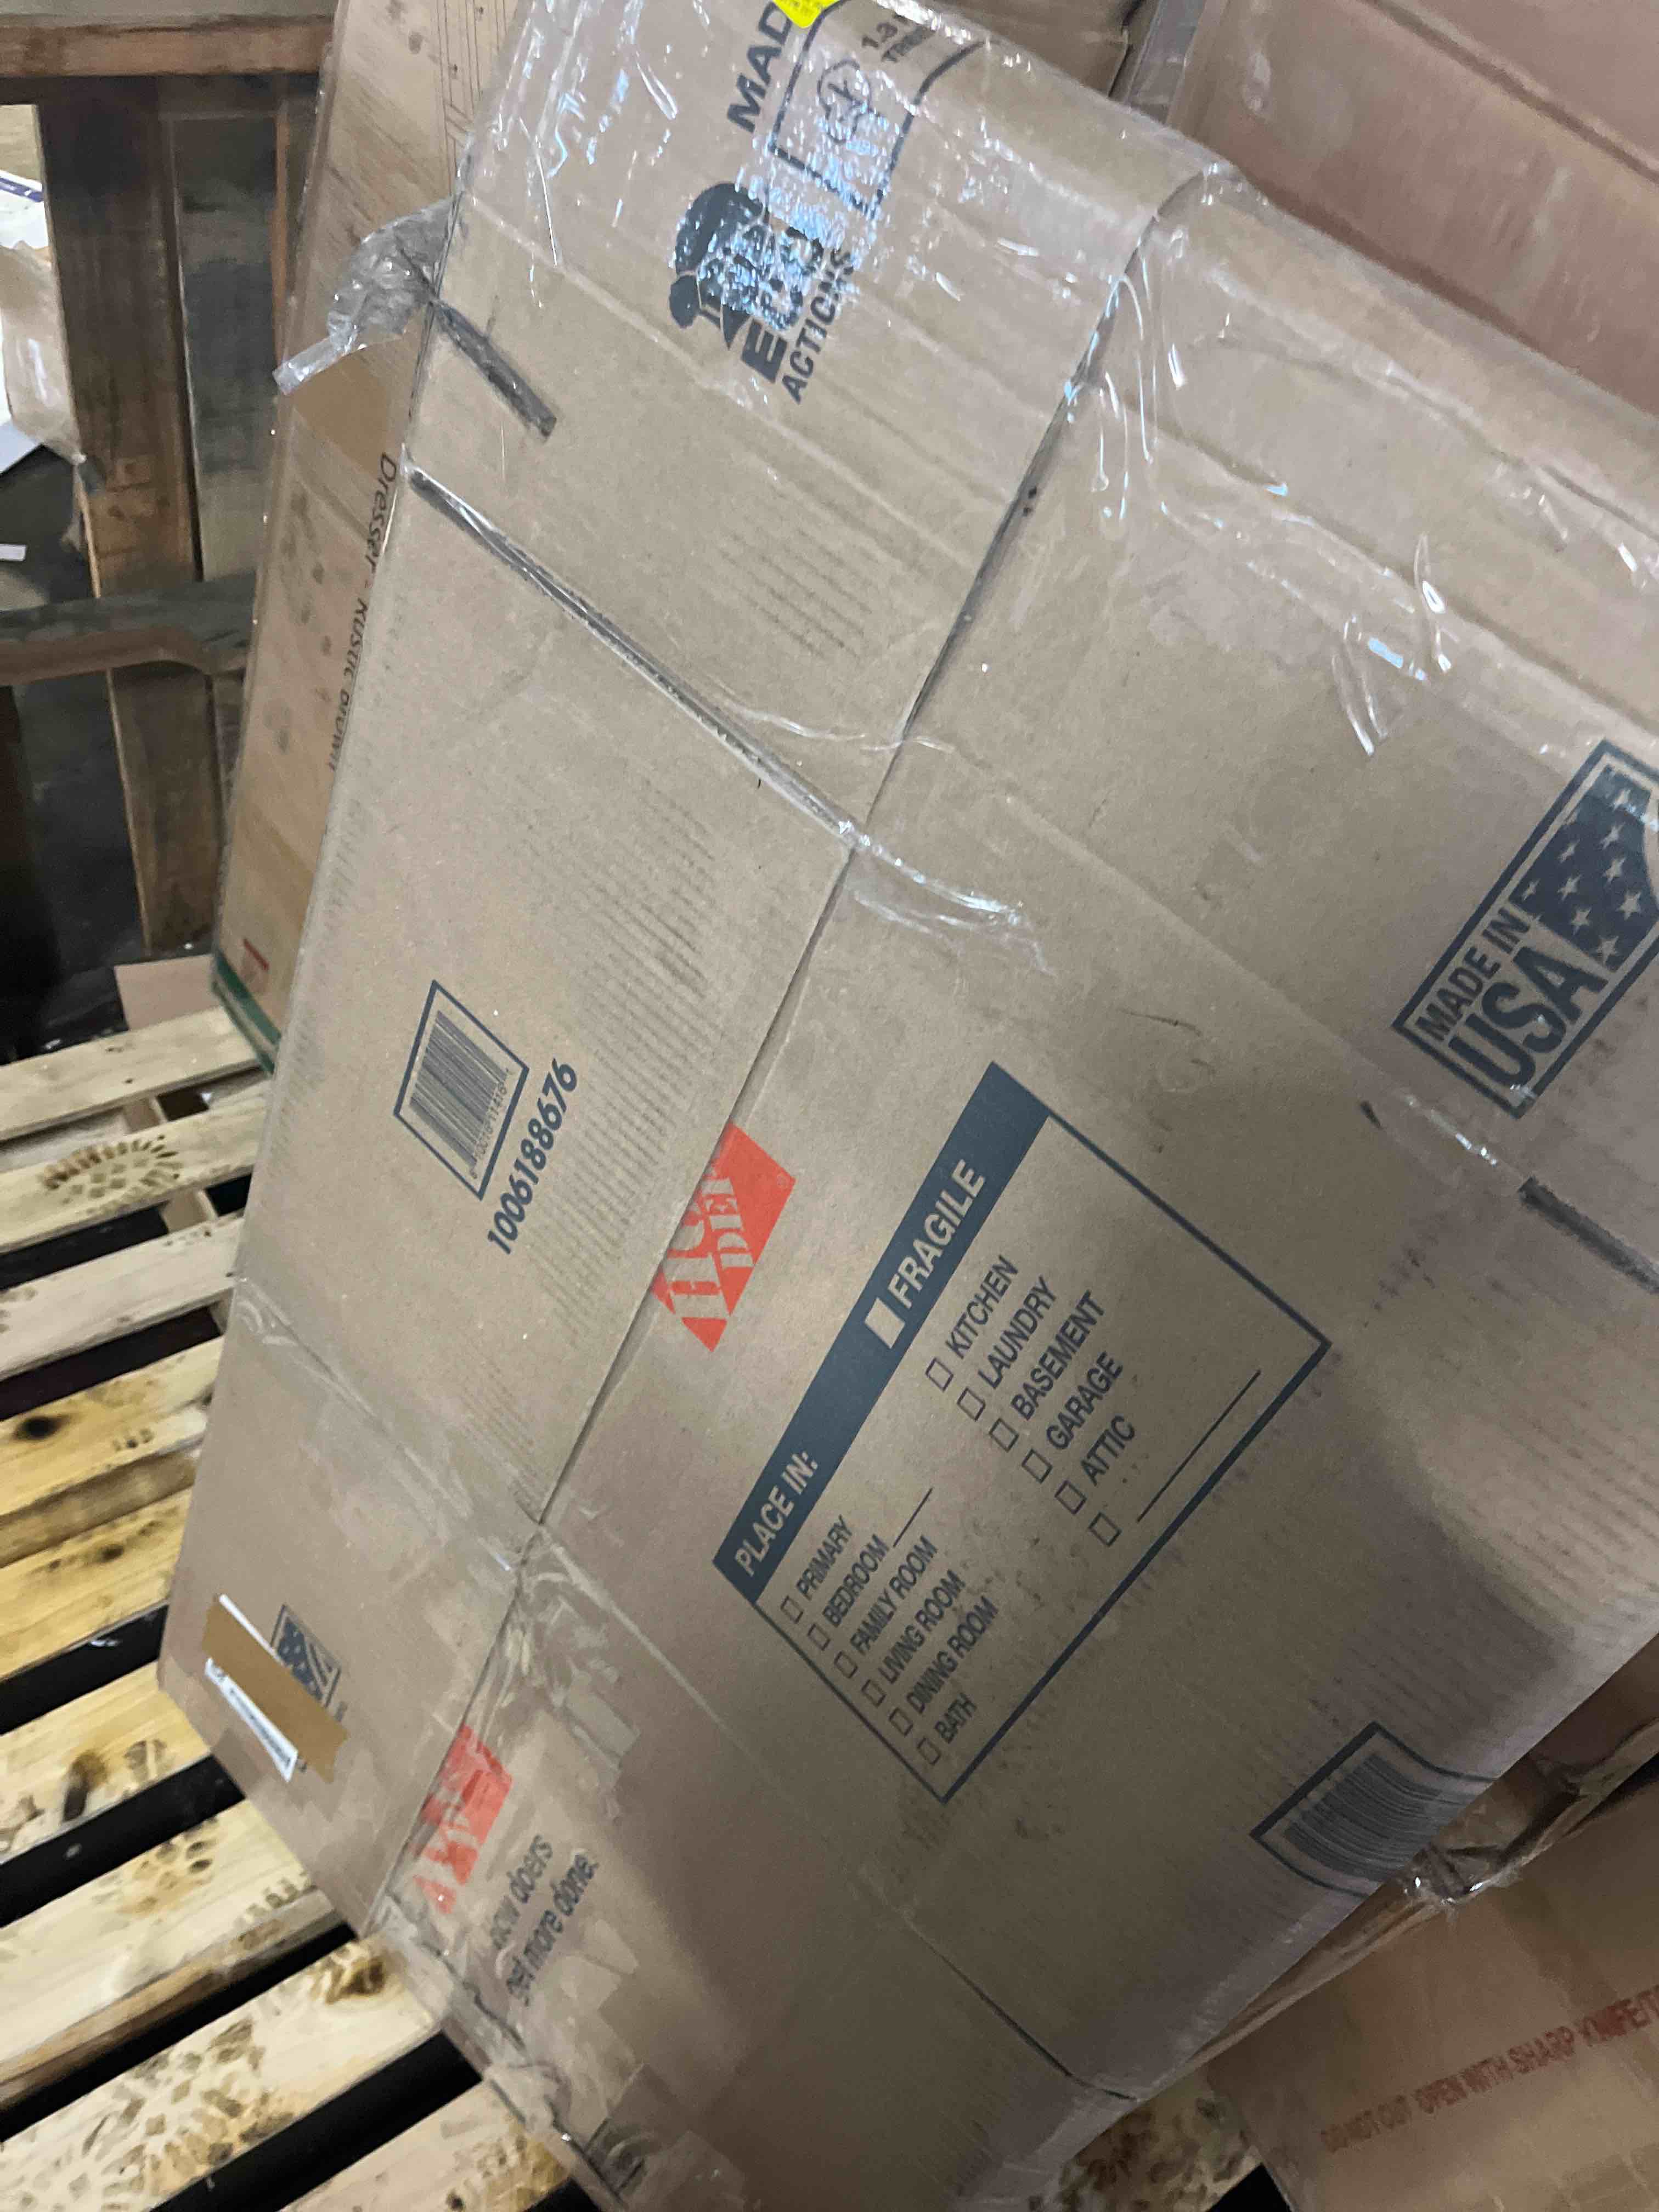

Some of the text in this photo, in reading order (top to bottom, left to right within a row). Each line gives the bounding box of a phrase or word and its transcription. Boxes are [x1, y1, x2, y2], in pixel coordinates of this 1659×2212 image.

[727, 1, 793, 133] MAD
[366, 452, 397, 572] Dresser
[1415, 905, 1533, 1042] MADE IN
[1448, 946, 1610, 1087] USA
[488, 1058, 578, 1255] 1006188676
[945, 1255, 1019, 1359] KITCHEN
[978, 1276, 1056, 1389] LAUNDRY
[1011, 1290, 1105, 1421] BASEMENT
[734, 1159, 986, 1577] PLACE IN: FRAGILE
[1046, 1351, 1124, 1451] GARAGE
[1080, 1415, 1136, 1486] ATTIC
[796, 1515, 853, 1600] PRIMARY
[823, 1534, 890, 1628] BEDROOM
[850, 1536, 938, 1656] FAMILY ROOM
[878, 1569, 966, 1685] LIVING ROOM
[906, 1595, 999, 1714] DINING ROOM
[935, 1692, 977, 1744] BATH
[1414, 2076, 1468, 2115] OPEN
[1462, 2055, 1513, 2094] WITH
[1508, 2025, 1576, 2074] SHARP
